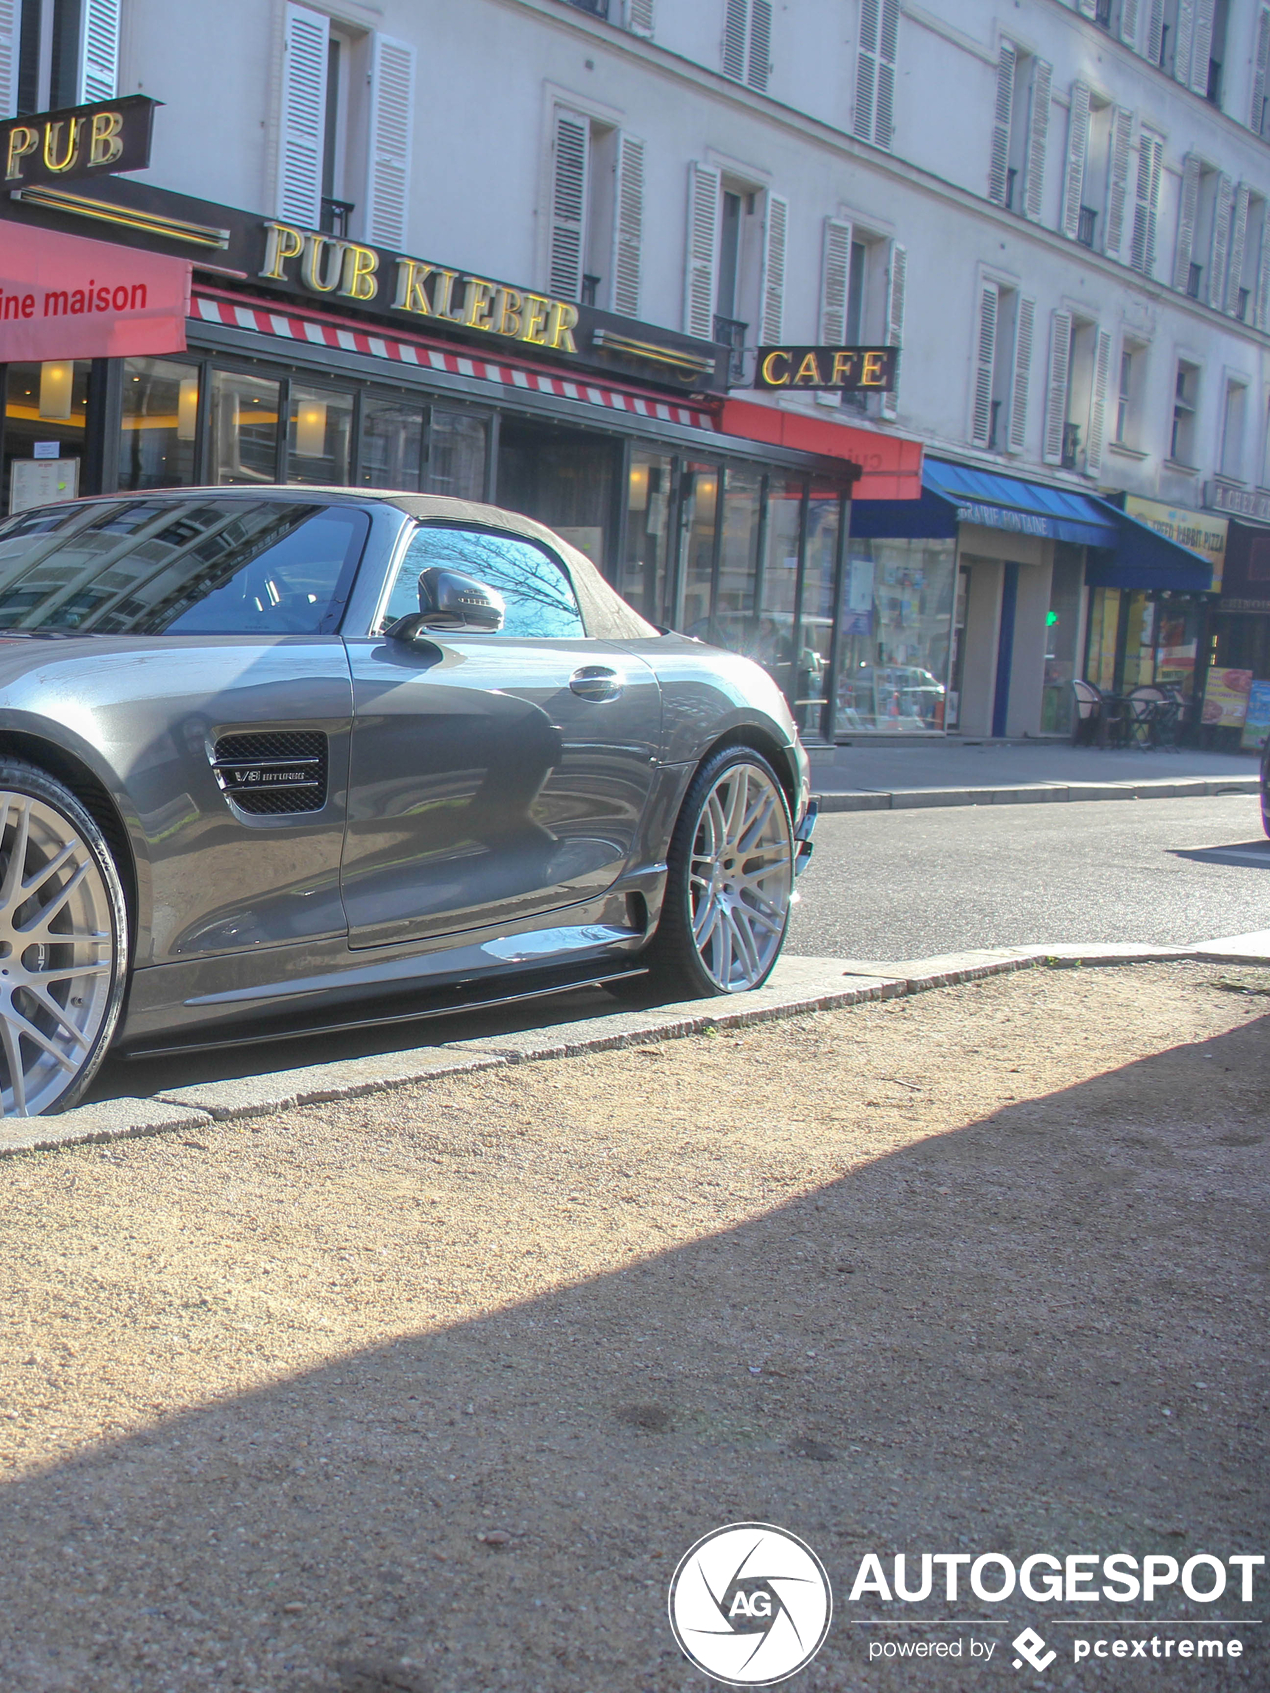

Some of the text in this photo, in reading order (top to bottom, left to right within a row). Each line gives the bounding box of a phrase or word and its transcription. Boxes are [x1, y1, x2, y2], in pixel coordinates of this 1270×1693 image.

[5, 112, 124, 181] PUB
[43, 279, 148, 317] maison
[258, 221, 579, 354] PUB KLEBER
[761, 351, 888, 386] CAFE
[1002, 510, 1048, 535] FONTAINE
[1204, 531, 1224, 553] PIZZA
[235, 771, 261, 782] V8
